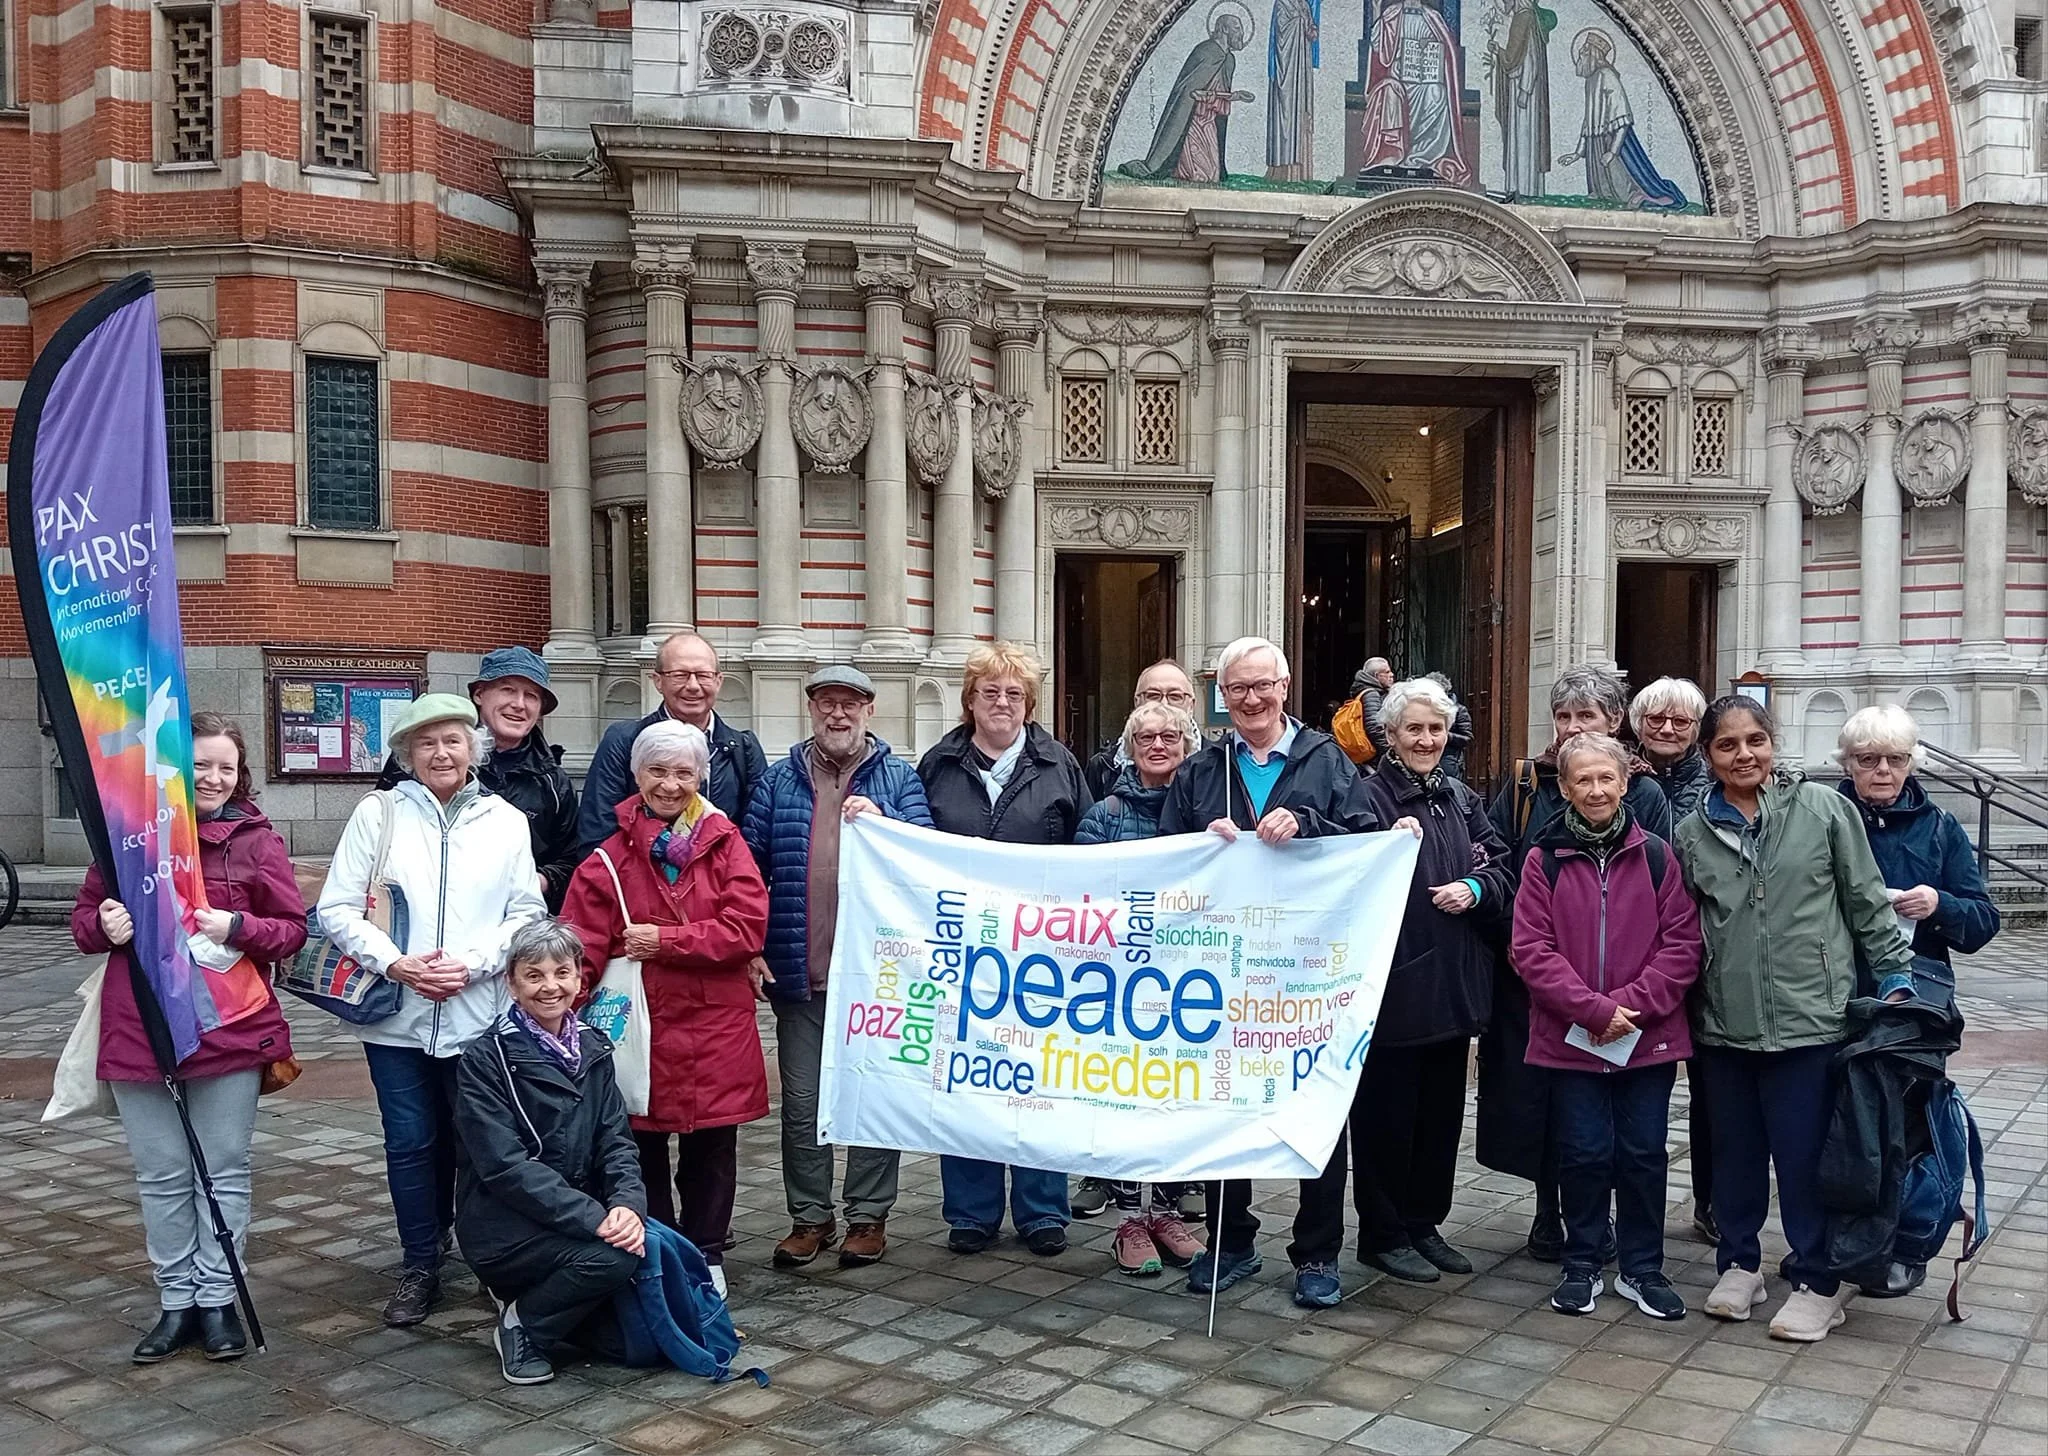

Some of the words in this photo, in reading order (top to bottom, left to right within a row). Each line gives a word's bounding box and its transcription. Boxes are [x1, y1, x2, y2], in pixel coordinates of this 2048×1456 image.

[37, 486, 98, 546] PAX
[60, 610, 130, 642] Movement
[272, 656, 353, 667] WESTMINSTER
[357, 658, 417, 670] CATHEDRAL
[93, 666, 148, 702] PEACE
[1012, 894, 1119, 952] paix
[1117, 890, 1156, 964] shanti
[1203, 912, 1236, 924] maano
[924, 890, 967, 983] salam
[1155, 924, 1228, 947] síocháin
[874, 939, 909, 960] paco
[1055, 945, 1112, 961] makonakon
[1302, 956, 1327, 969] freed
[875, 959, 902, 1001] pax
[1245, 972, 1276, 988] peoch
[957, 945, 1223, 1044] peace
[1227, 990, 1323, 1024] shalom
[588, 1004, 620, 1016] PROUD
[938, 1003, 959, 1016] patz
[600, 1017, 614, 1029] BE
[846, 1002, 904, 1046] paz
[993, 1023, 1035, 1048] rahu
[975, 1039, 1009, 1053] salaam
[1101, 1042, 1131, 1055] damai
[1232, 1018, 1334, 1054] tangnefedd
[1148, 1045, 1168, 1056] solh
[1175, 1047, 1208, 1060] patcha
[947, 1050, 1034, 1095] pace
[1040, 1032, 1200, 1101] frieden
[1209, 1049, 1232, 1102] bakea
[1240, 1055, 1285, 1077] béke
[1262, 1077, 1276, 1104] freda
